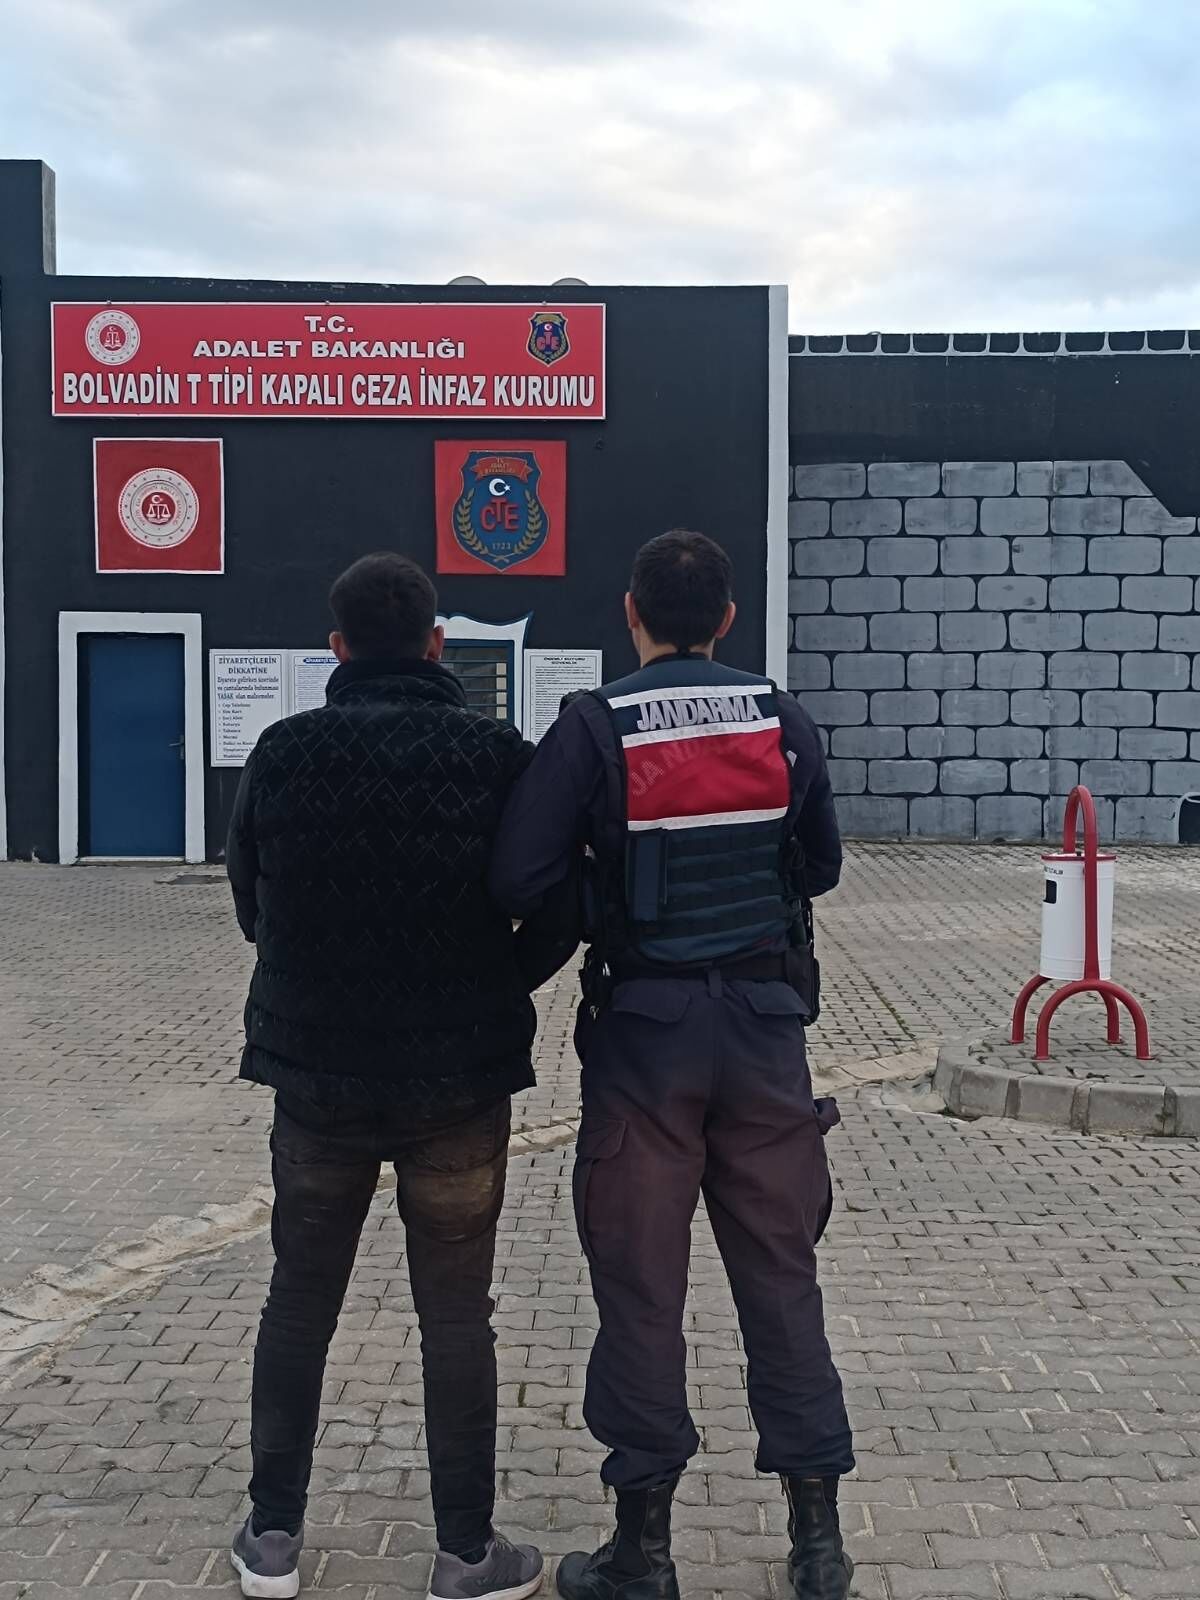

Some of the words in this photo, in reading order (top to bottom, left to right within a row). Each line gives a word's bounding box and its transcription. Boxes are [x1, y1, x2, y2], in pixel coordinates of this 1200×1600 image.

[304, 315, 354, 333] T.C.
[193, 341, 302, 358] ADALET
[311, 337, 465, 358] BAKANLIĞI
[63, 365, 179, 404] BOLVADİN
[187, 373, 202, 405] T
[208, 366, 253, 405] TİPİ
[261, 374, 343, 406] KAPALI
[351, 374, 412, 406] CEZA
[420, 367, 487, 406] İNFAZ
[494, 375, 595, 407] KURUMU
[481, 497, 519, 530] CTE
[218, 656, 277, 665] ZİYARETÇİLERİN
[637, 695, 764, 730] JANDARMA
